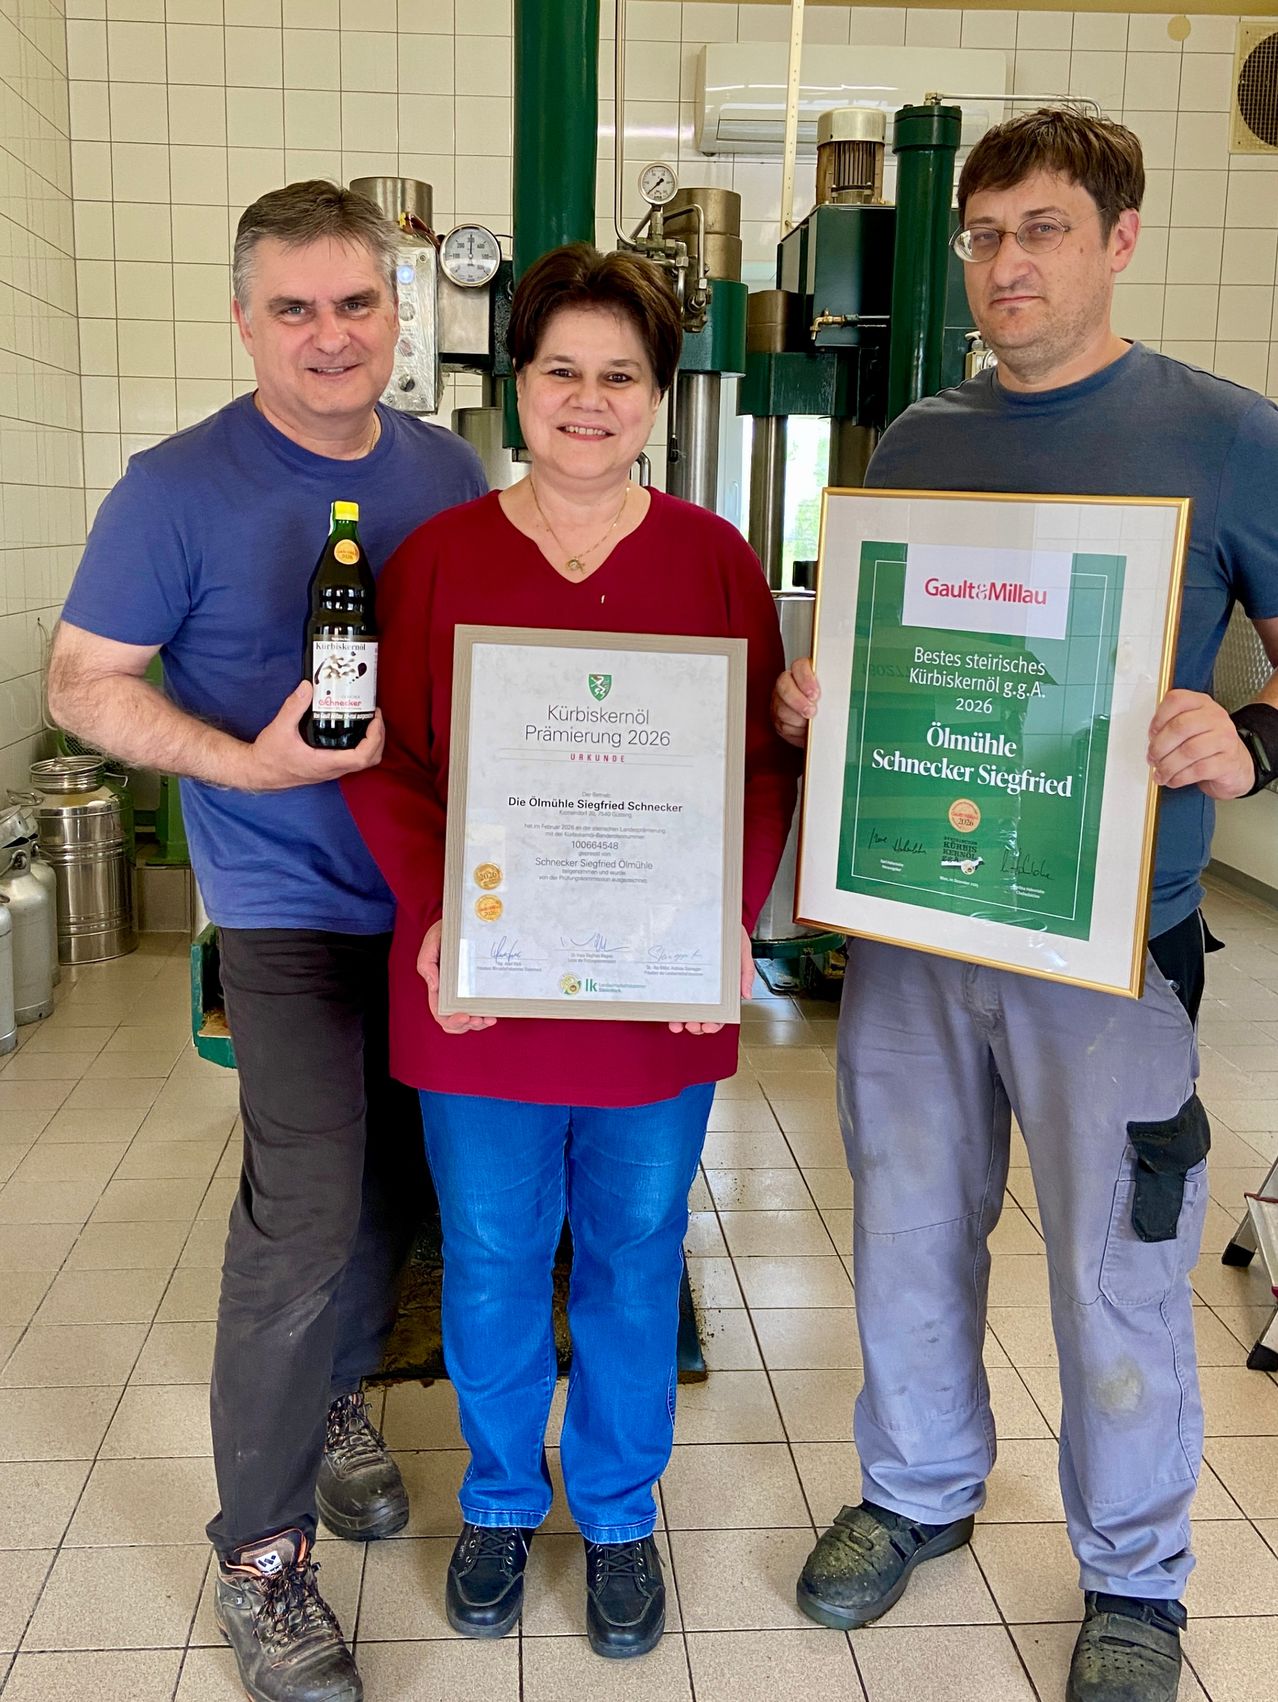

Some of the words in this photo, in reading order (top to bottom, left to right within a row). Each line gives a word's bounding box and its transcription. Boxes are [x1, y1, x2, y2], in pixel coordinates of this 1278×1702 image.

[924, 578, 1047, 605] Gault&Millau
[914, 647, 961, 667] Bestes
[965, 653, 1046, 676] steirisches
[909, 668, 1000, 693] Kürbiskernöl
[1003, 681, 1046, 700] g.g.A.
[547, 705, 650, 725] Kürbiskernöl
[955, 698, 993, 714] 2026
[525, 725, 622, 748] Prämierung
[628, 730, 671, 746] 2026
[926, 721, 1017, 758] Ölmühle
[570, 753, 625, 763] URKUNDE
[871, 749, 975, 782] Schnecker
[977, 764, 1073, 797] Siegfried
[508, 796, 526, 807] Die
[529, 796, 574, 808] Ölmühle
[577, 799, 625, 812] Siegfried
[628, 801, 683, 813] Schnecker
[571, 840, 620, 850] 100664548
[535, 858, 578, 867] Schnecker
[580, 858, 616, 870] Siegfried
[618, 859, 653, 870] Ölmühle
[585, 979, 598, 993] lk
